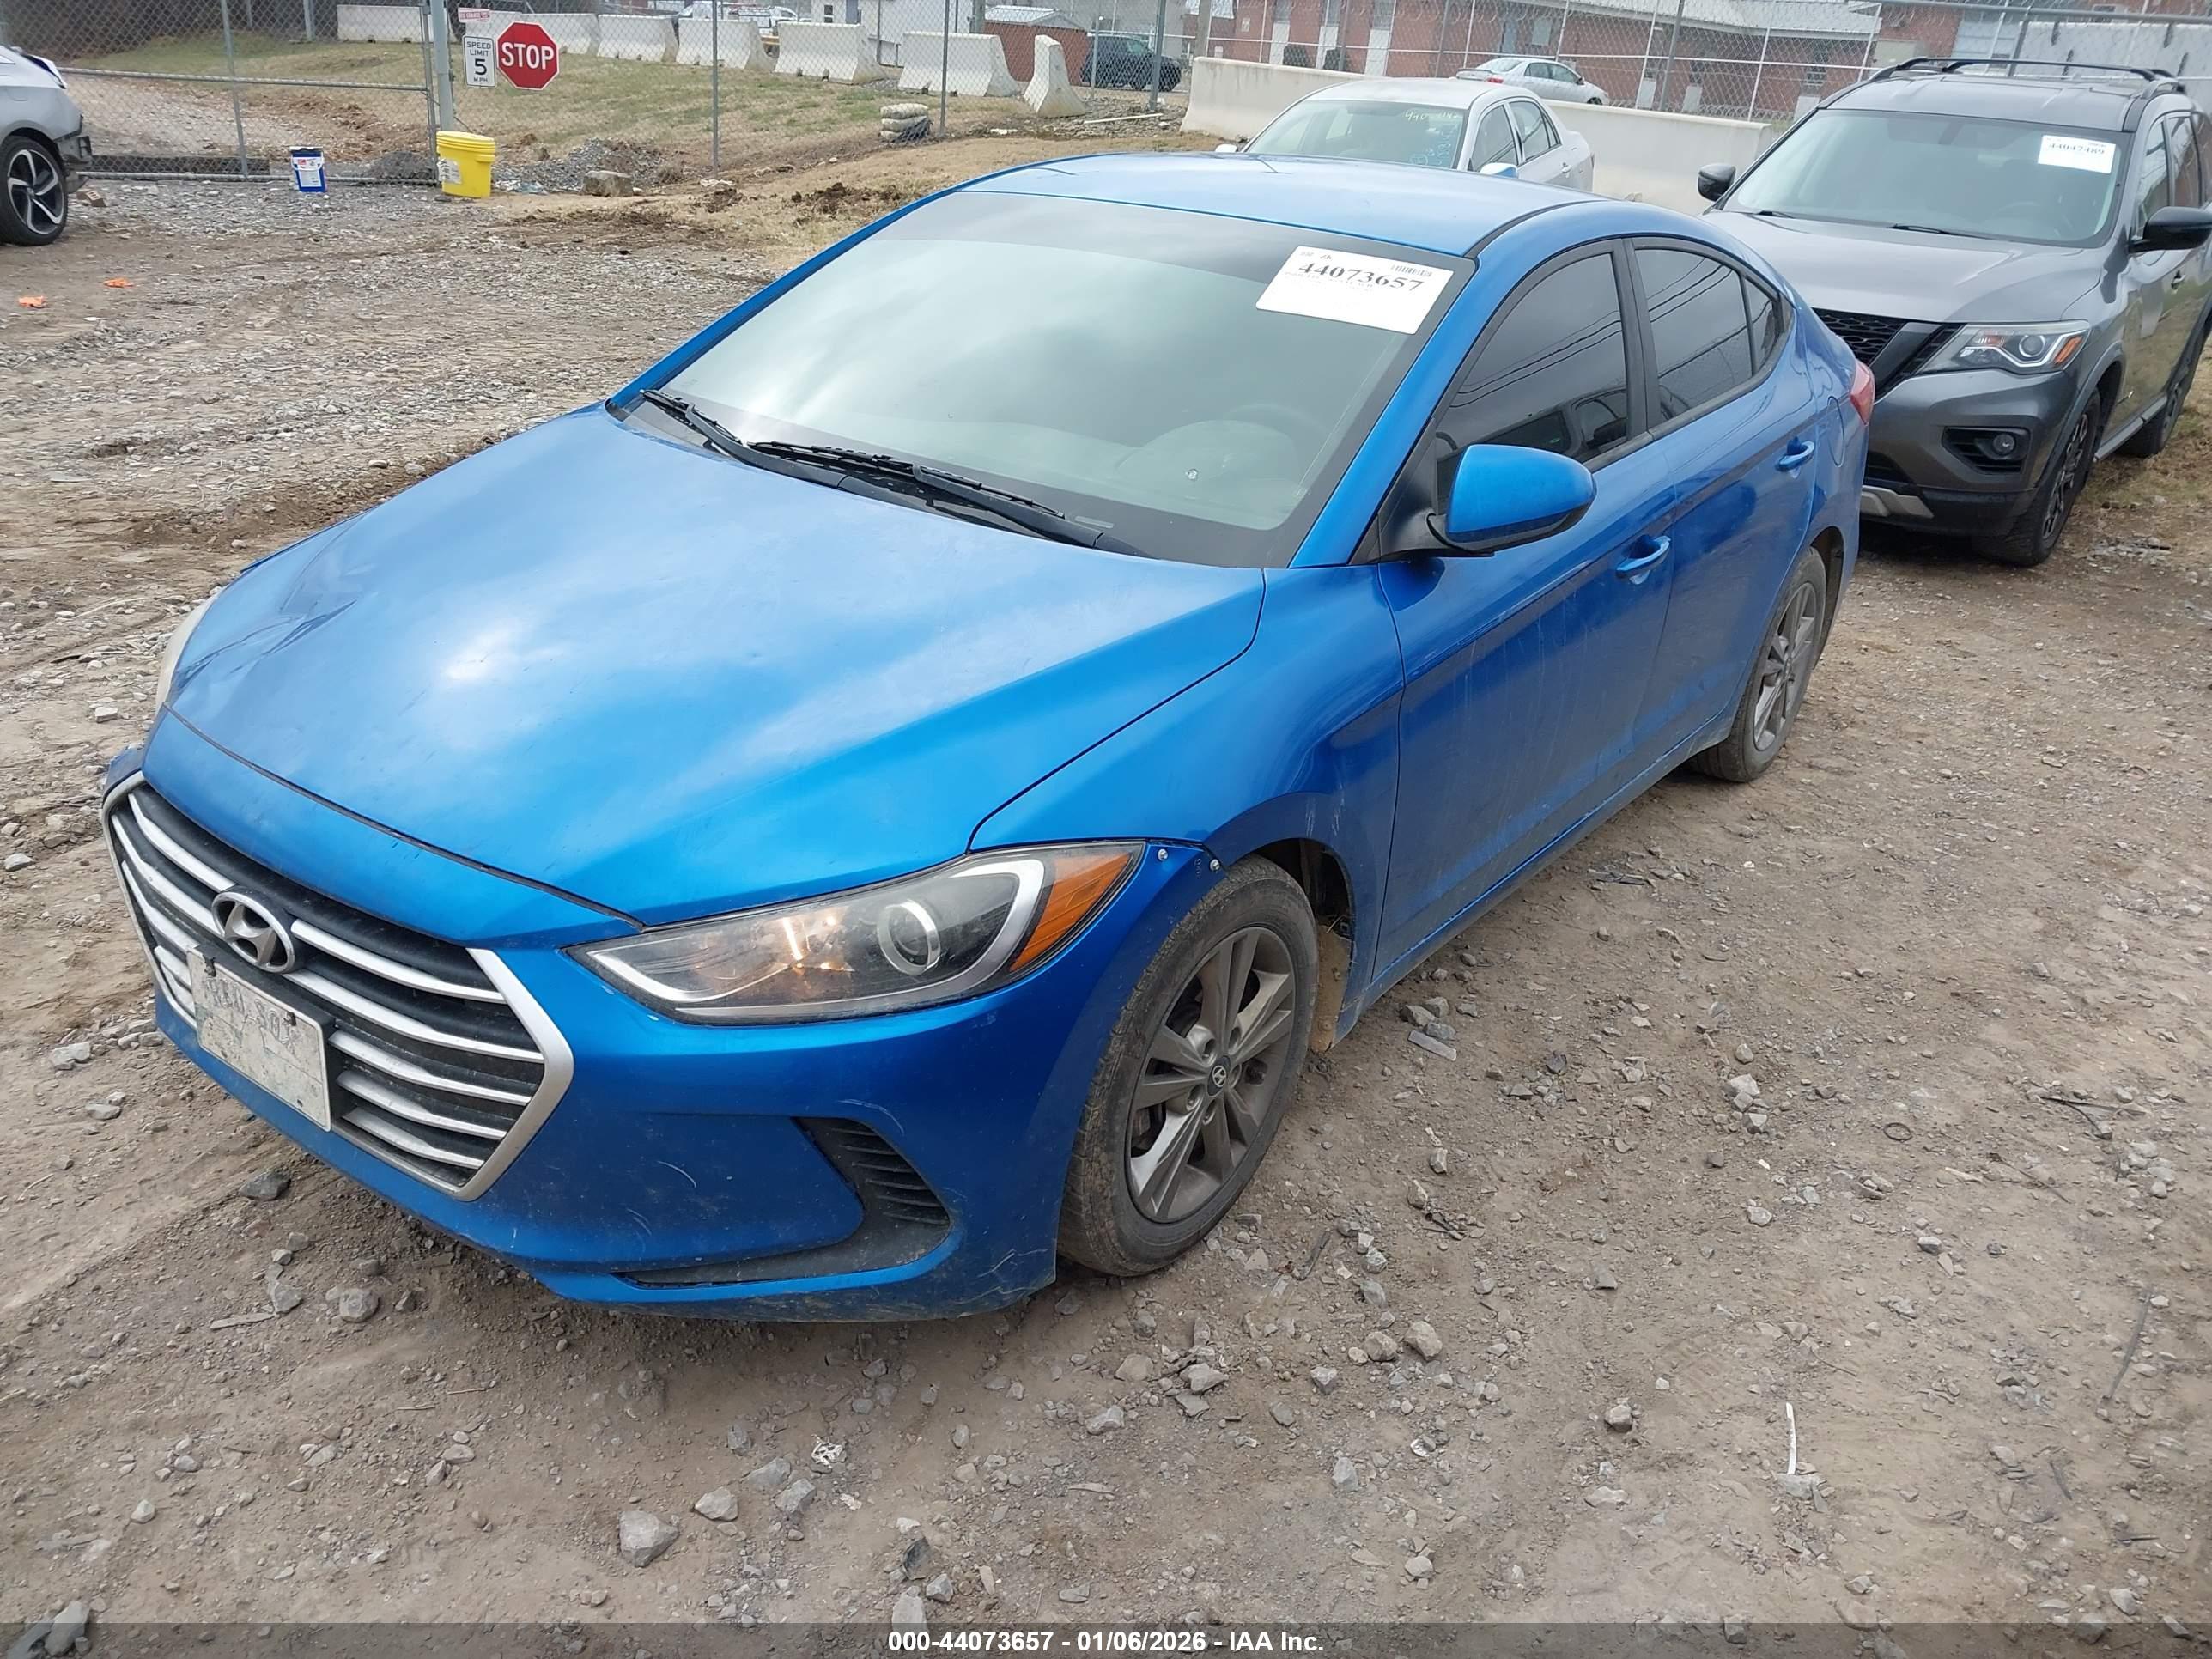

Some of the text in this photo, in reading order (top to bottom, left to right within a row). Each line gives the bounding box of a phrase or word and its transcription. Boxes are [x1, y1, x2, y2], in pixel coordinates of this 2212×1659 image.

[475, 58, 487, 76] 5
[501, 42, 554, 70] STOP
[1298, 263, 1425, 291] 44073657
